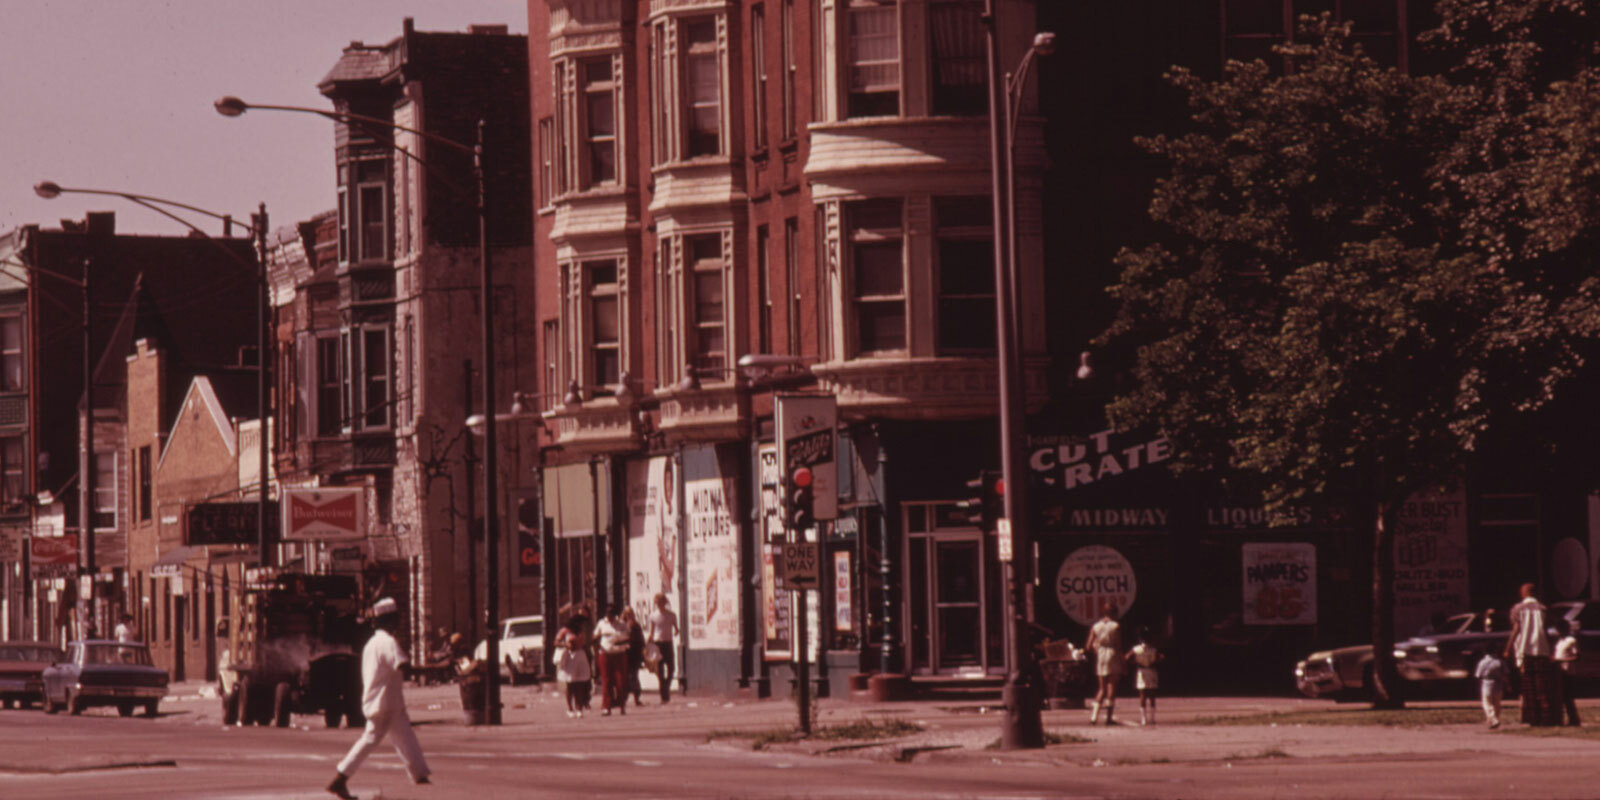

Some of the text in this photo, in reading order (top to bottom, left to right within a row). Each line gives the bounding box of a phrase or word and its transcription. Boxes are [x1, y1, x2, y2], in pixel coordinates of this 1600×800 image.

[1030, 428, 1116, 472] CUT
[1064, 436, 1171, 490] RATE
[294, 506, 353, 520] Budweiser
[1070, 506, 1313, 529] MIDWAY LIQUS
[1421, 501, 1463, 518] BUST
[786, 546, 815, 559] ONE
[786, 560, 816, 572] WAY
[1247, 562, 1309, 584] PAMPERS
[1060, 575, 1129, 595] SCOTCH
